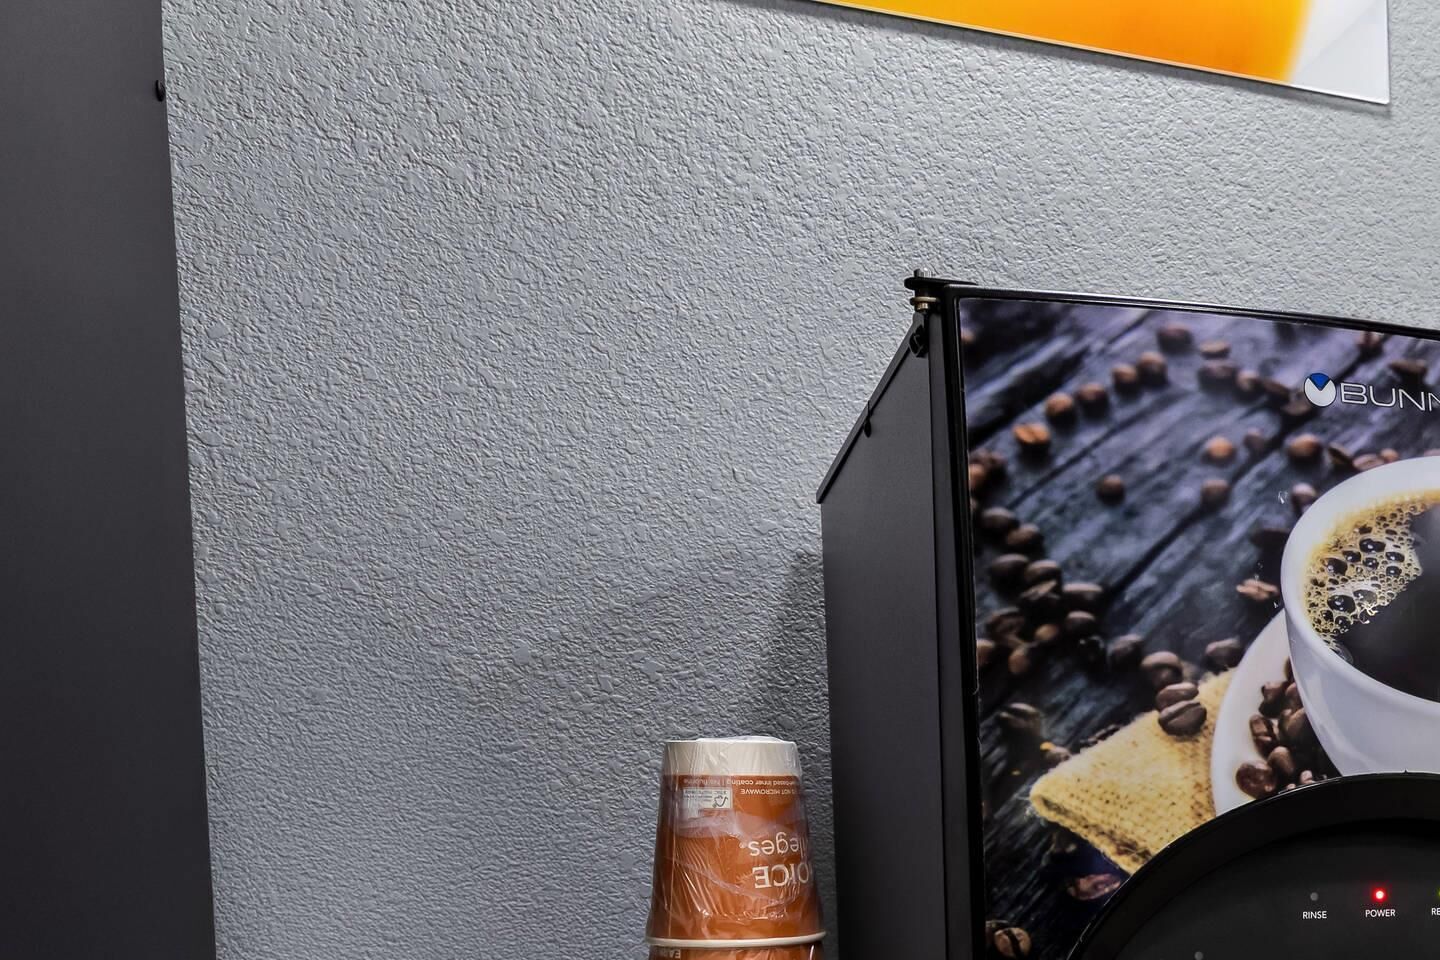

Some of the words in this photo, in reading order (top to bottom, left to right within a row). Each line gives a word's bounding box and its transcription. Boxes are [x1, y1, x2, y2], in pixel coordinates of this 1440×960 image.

[752, 863, 809, 889] OICE
[1302, 911, 1327, 920] RINSE
[1365, 909, 1396, 917] POWER
